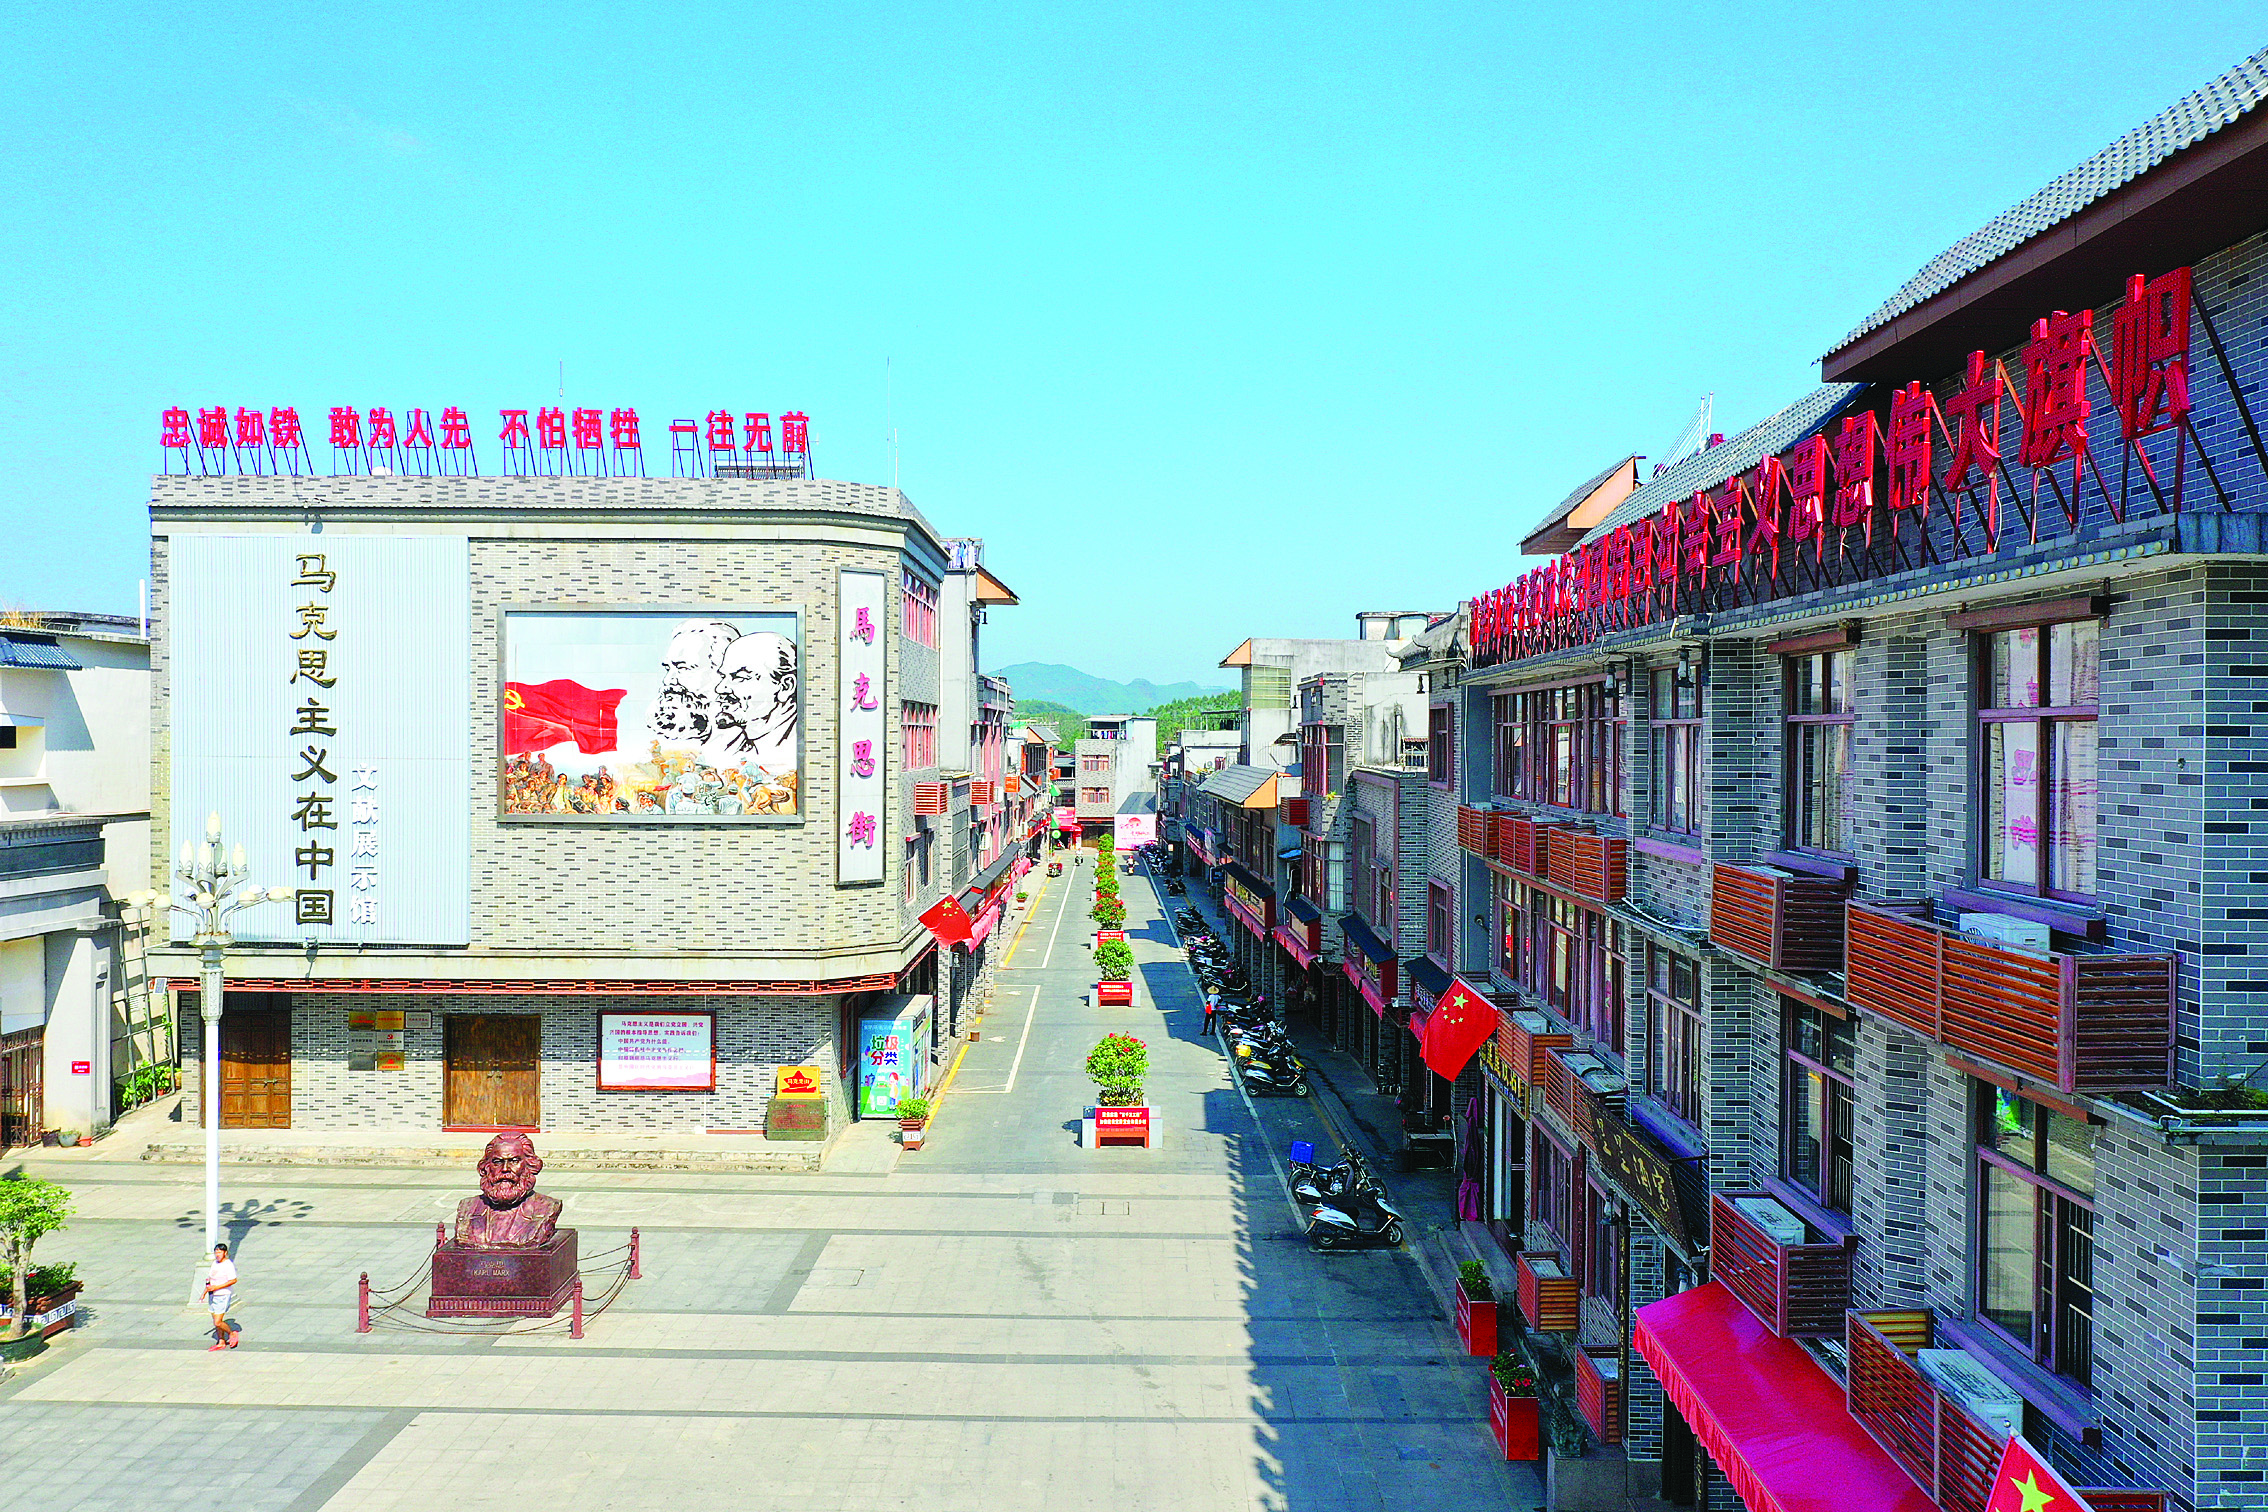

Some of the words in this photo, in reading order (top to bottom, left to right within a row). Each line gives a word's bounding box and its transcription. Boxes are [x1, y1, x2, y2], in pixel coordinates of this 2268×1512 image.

[160, 406, 301, 448] 忠诚如铁
[328, 406, 472, 449] 敢为人先
[498, 407, 641, 449] 不怕牺牲
[669, 409, 809, 453] 一往无前
[289, 553, 338, 925] 马克思主义在中国
[845, 606, 879, 848] 馬克思街
[350, 762, 379, 925] 文献展示馆
[870, 1051, 899, 1066] 分类
[871, 1035, 899, 1051] 垃圾
